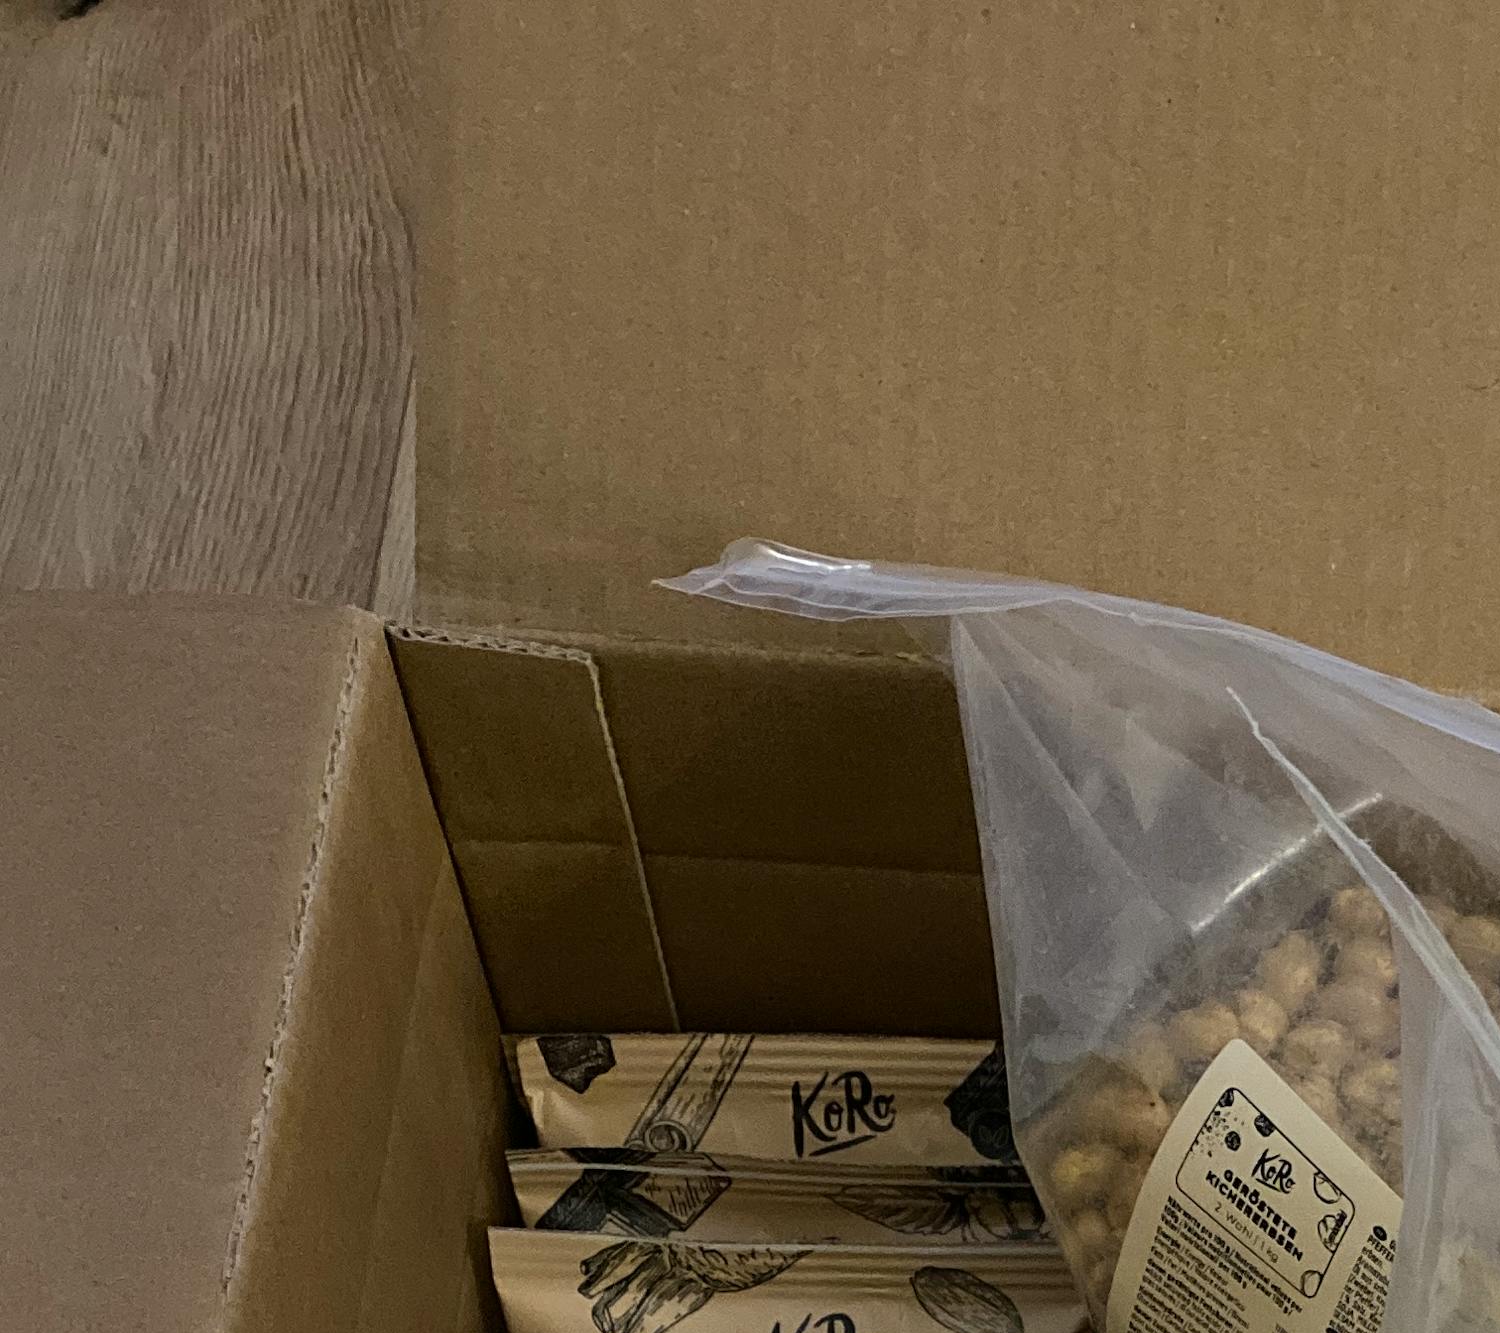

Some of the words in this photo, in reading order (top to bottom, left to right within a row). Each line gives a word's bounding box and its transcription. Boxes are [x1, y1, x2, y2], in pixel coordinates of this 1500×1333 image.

[792, 1070, 896, 1156] KoRo
[1224, 1169, 1297, 1240] GERÖSTETE
[1251, 1148, 1295, 1194] KoRo
[1206, 1170, 1303, 1261] KICHERERBSEN
